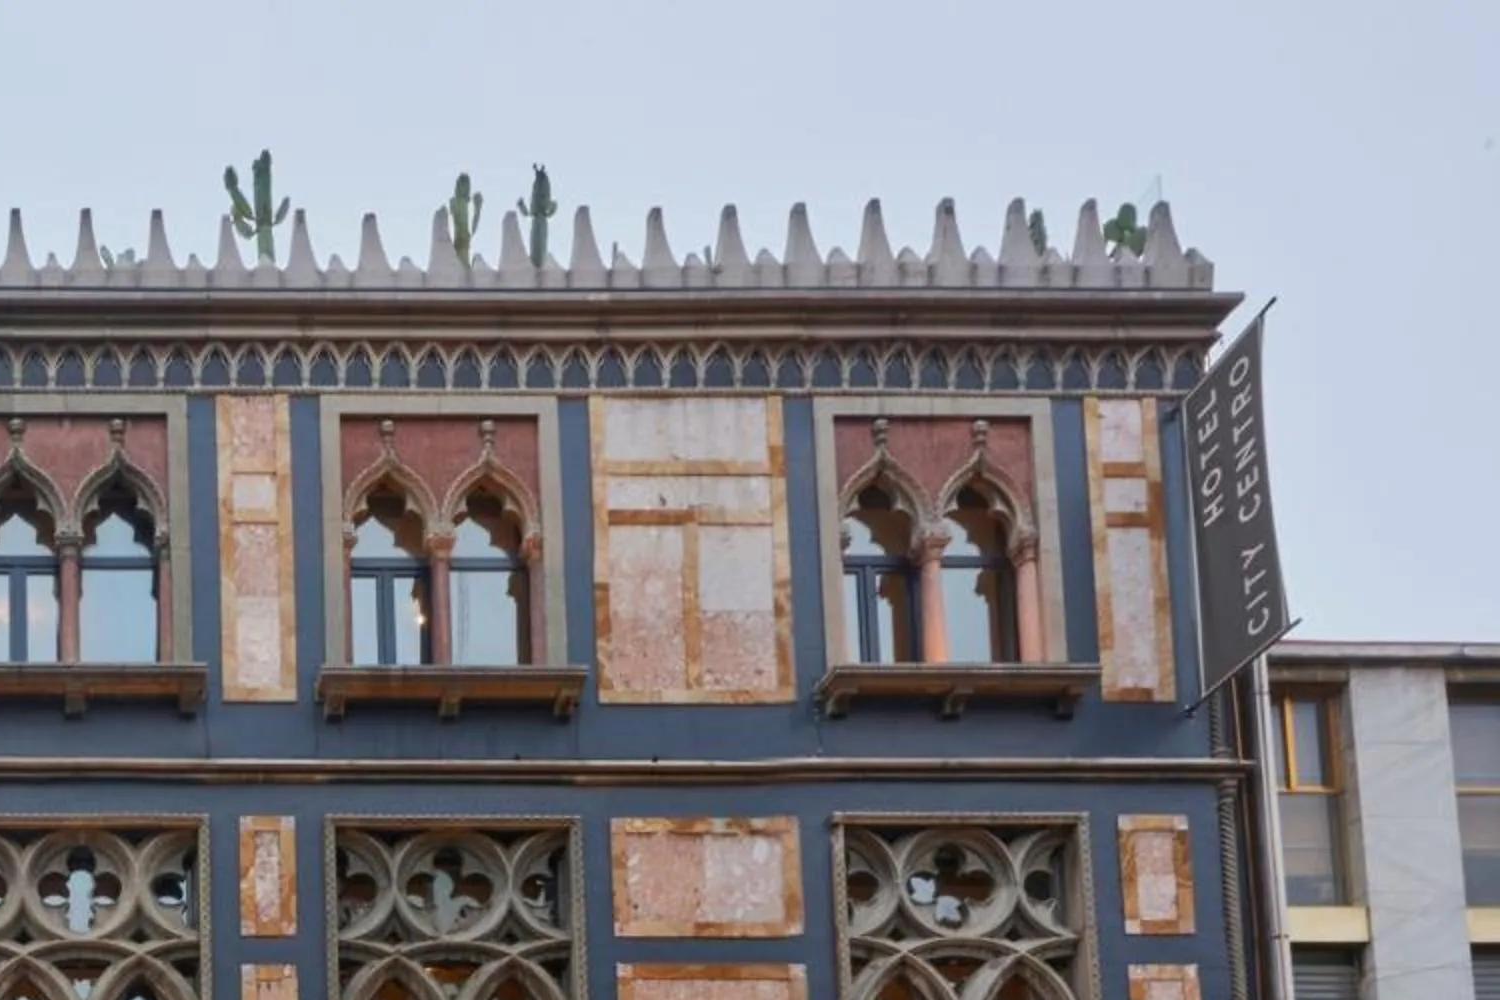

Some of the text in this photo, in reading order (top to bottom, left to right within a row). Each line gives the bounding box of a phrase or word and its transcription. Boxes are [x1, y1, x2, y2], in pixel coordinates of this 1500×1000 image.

[1198, 388, 1224, 527] HOTEL
[1229, 355, 1269, 635] CITY CENTRO
